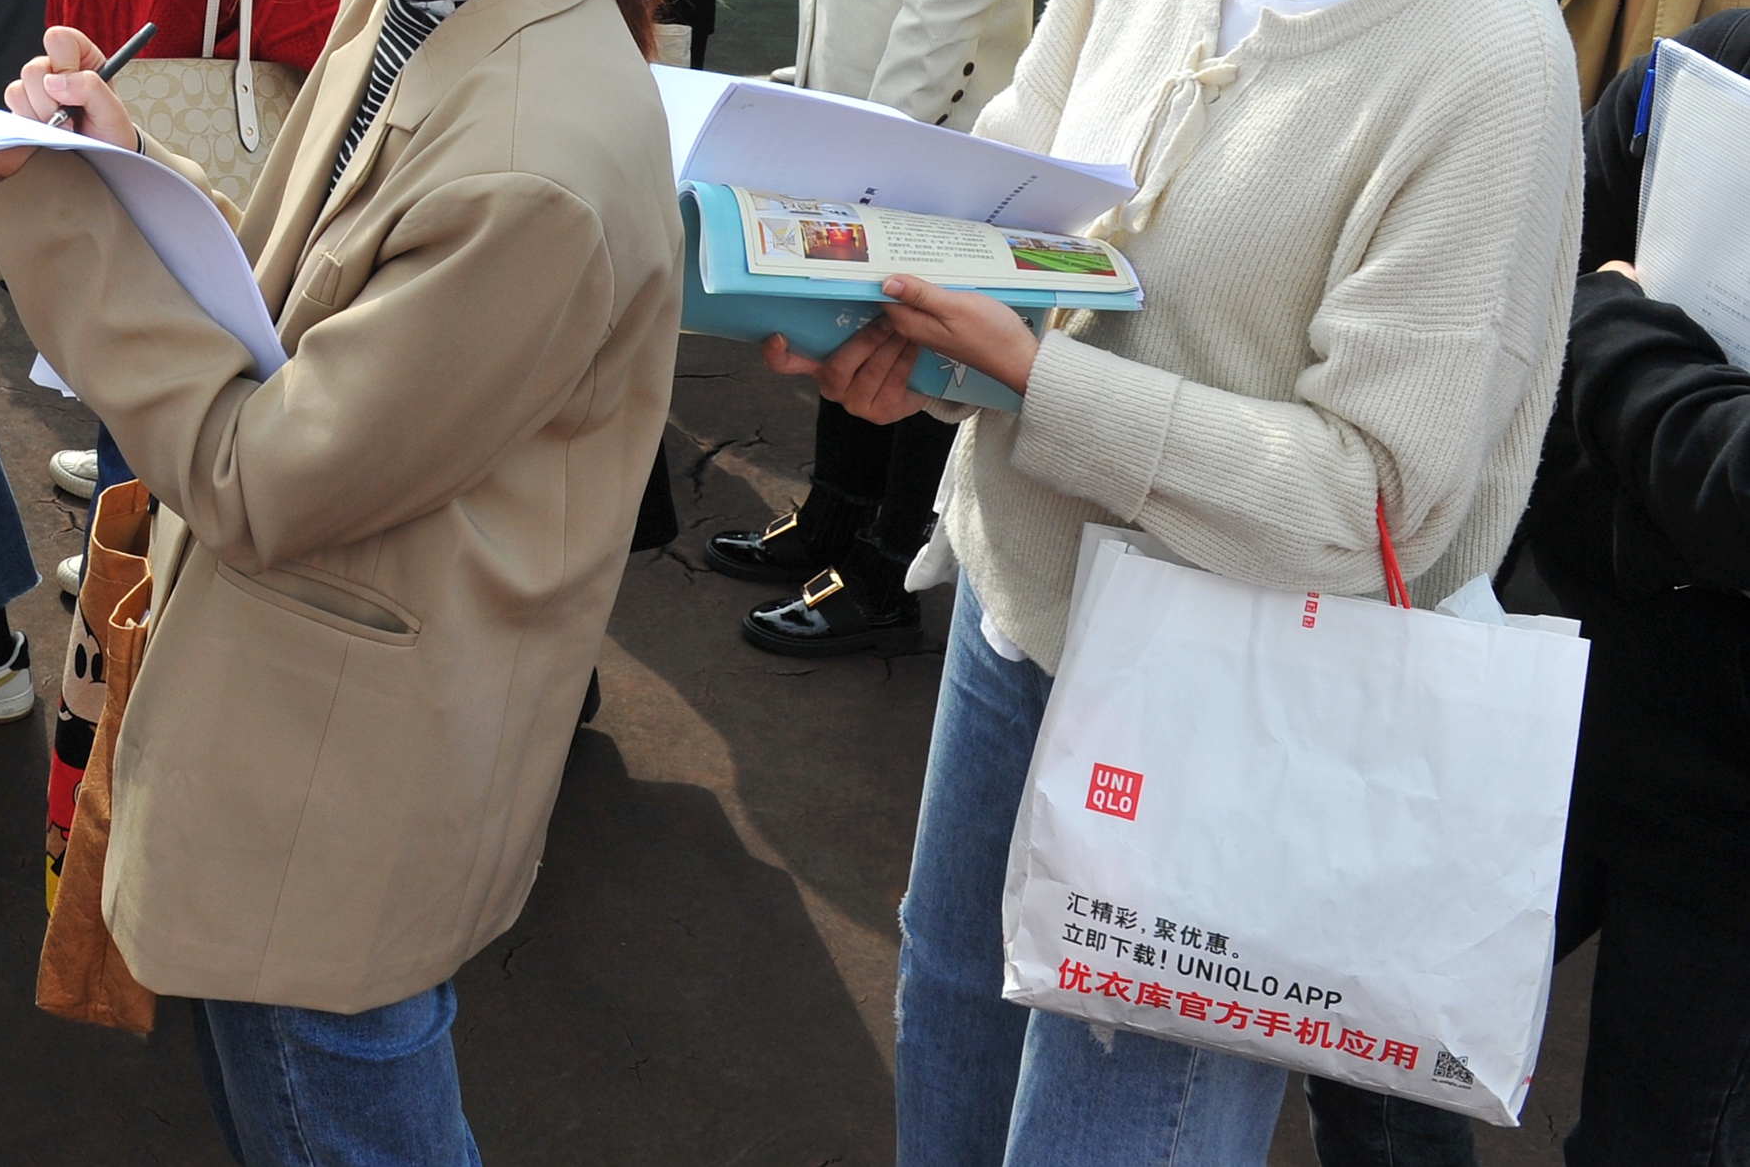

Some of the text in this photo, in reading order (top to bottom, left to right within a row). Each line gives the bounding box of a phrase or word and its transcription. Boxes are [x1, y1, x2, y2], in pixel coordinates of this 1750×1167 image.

[1092, 787, 1133, 814] QLO
[1096, 767, 1133, 795] UNI
[1177, 953, 1279, 997] UNIQLO
[1284, 981, 1343, 1009] APP
[1057, 957, 1419, 1070] 优衣库官方手机应用
